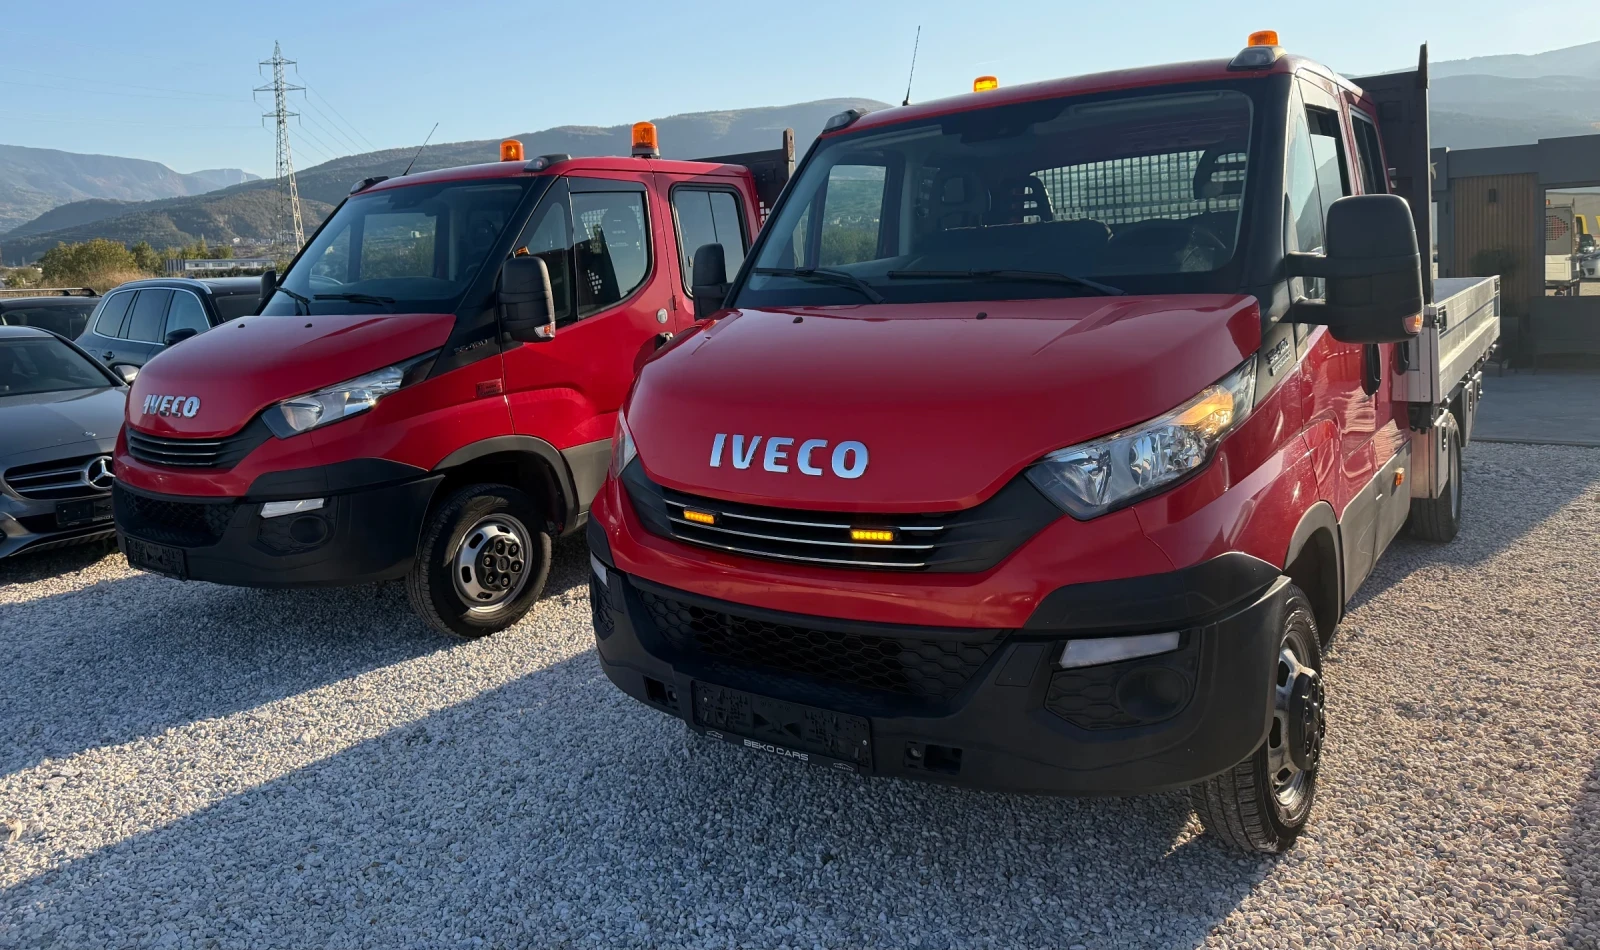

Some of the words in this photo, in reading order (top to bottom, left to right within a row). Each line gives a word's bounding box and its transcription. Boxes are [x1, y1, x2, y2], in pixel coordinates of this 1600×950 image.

[142, 393, 201, 418] IVECO
[709, 432, 870, 479] IVECO
[743, 738, 775, 753] BEKO
[776, 747, 809, 761] CARS
